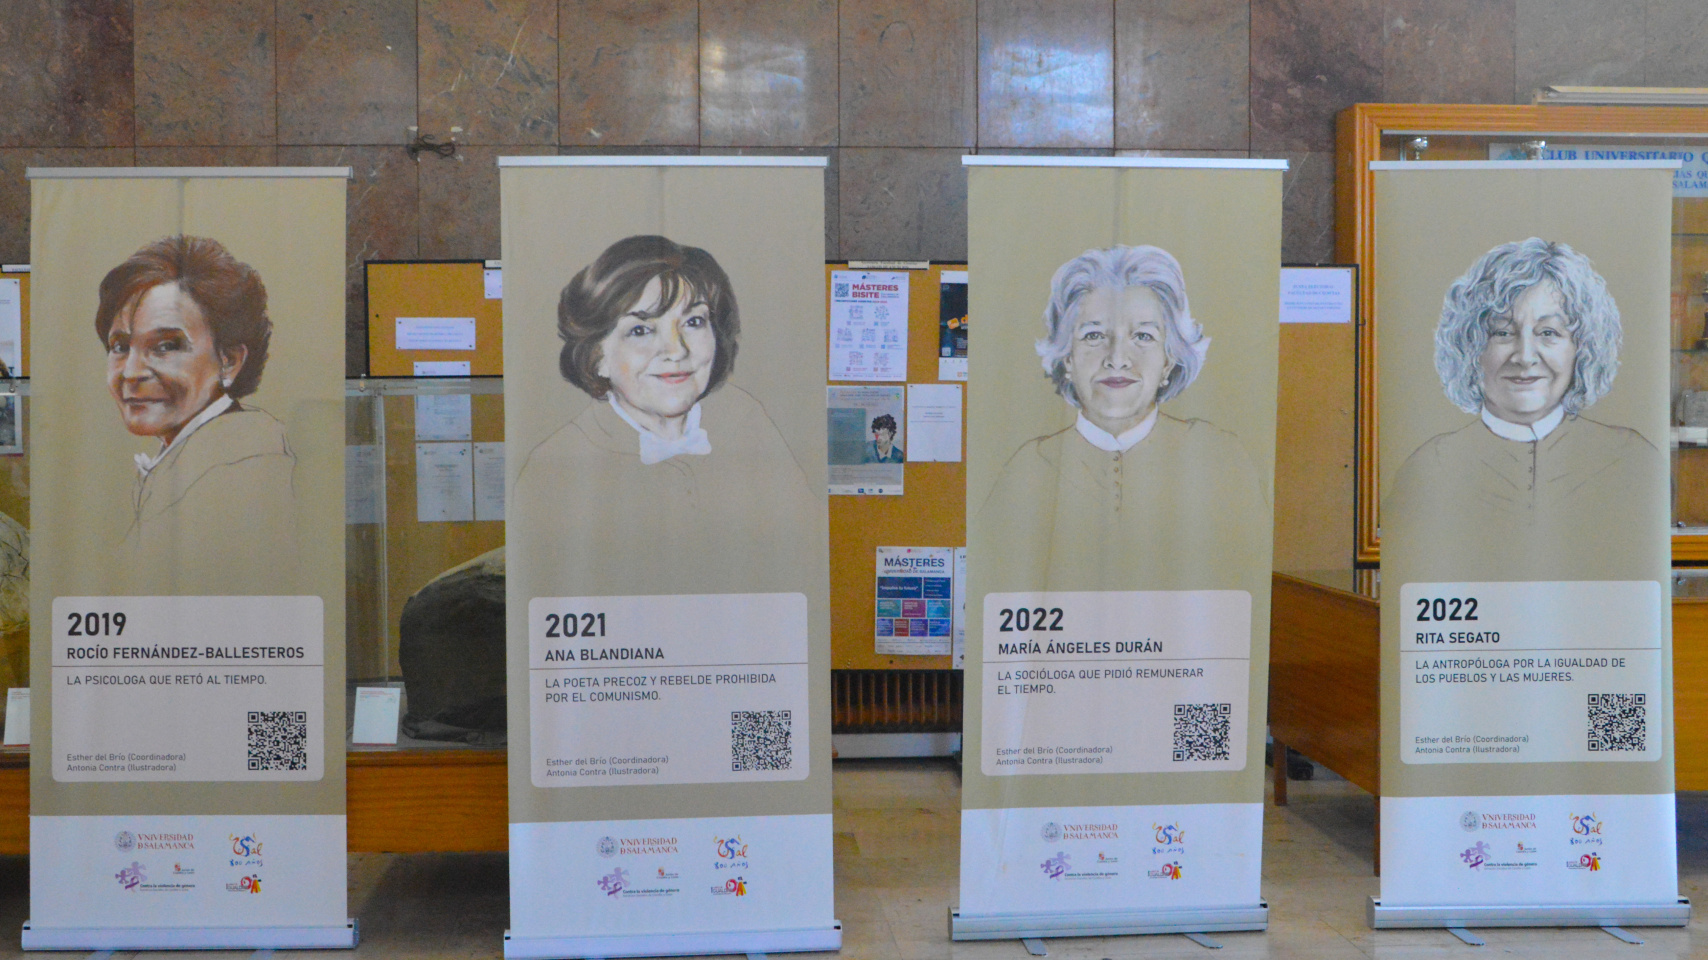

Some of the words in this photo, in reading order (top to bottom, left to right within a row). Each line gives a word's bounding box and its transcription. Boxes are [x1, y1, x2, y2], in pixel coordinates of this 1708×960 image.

[1542, 150, 1577, 160] CLUB
[1585, 150, 1694, 162] UNIVERSITARIO
[852, 282, 899, 291] MÁSTERES
[884, 555, 945, 567] MÁSTERES
[1417, 597, 1478, 621] 2022
[67, 612, 127, 636] 2019
[545, 612, 606, 638] 2021
[999, 607, 1064, 632] 2022
[1416, 632, 1445, 644] RITA
[1448, 632, 1500, 644] SEGATO
[67, 644, 109, 660] ROCÍO
[113, 644, 305, 659] FERNÁNDEZ-BALLESTEROS
[999, 639, 1041, 655] MARÍA
[1046, 639, 1111, 654] ÁNGELES
[1115, 638, 1163, 653] DURÁN
[545, 649, 575, 661] ANA
[580, 647, 664, 661] BLANDIANA
[1415, 660, 1430, 670] LA
[1432, 657, 1510, 669] ANTROPÓLOGA
[1513, 658, 1534, 668] POR
[1537, 658, 1551, 668] LA
[1554, 658, 1608, 668] IGUALDAD
[1612, 658, 1625, 667] DE
[67, 675, 81, 685] LA
[85, 675, 146, 685] PSICOLOGA
[149, 675, 171, 685] QUE
[175, 671, 203, 685] RETÓ
[206, 675, 221, 685] AL
[224, 675, 267, 685] TIEMPO.
[998, 671, 1012, 680] LA
[1015, 667, 1075, 680] SOCIÓLOGA
[1079, 669, 1101, 679] QUE
[1104, 666, 1132, 679] PIDIÓ
[1136, 668, 1203, 678] REMUNERAR
[1416, 674, 1436, 684] LOS
[1439, 673, 1487, 683] PUEBLOS
[1490, 673, 1497, 683] Y
[1500, 673, 1520, 683] LAS
[1523, 672, 1574, 682] MUJERES.
[545, 678, 561, 688] LA
[564, 677, 600, 688] POETA
[603, 676, 647, 687] PRECOZ
[650, 676, 657, 686] Y
[660, 675, 711, 686] REBELDE
[716, 673, 776, 685] PROHIBIDA
[998, 685, 1010, 695] EL
[1013, 684, 1056, 694] TIEMPO.
[545, 692, 569, 702] POR
[572, 692, 587, 702] EL
[590, 690, 661, 702] COMUNISMO.
[1415, 736, 1439, 744] Esther
[1441, 735, 1453, 743] del
[1473, 734, 1529, 743] (Coordinadora)
[996, 748, 1021, 756] Esther
[1023, 747, 1035, 755] del
[1056, 745, 1113, 755] (Coordinadora)
[1415, 746, 1443, 754] Antonia
[67, 753, 92, 761] Esther
[95, 753, 107, 761] del
[127, 753, 186, 762] (Coordinadora)
[547, 758, 572, 766] Esther
[609, 755, 669, 765] (Coordinadora)
[1027, 757, 1053, 765] Contra
[67, 764, 96, 772] Antonia
[546, 769, 577, 777] Antonia
[579, 768, 606, 776] Contra
[626, 846, 678, 854] SALAMANCA
